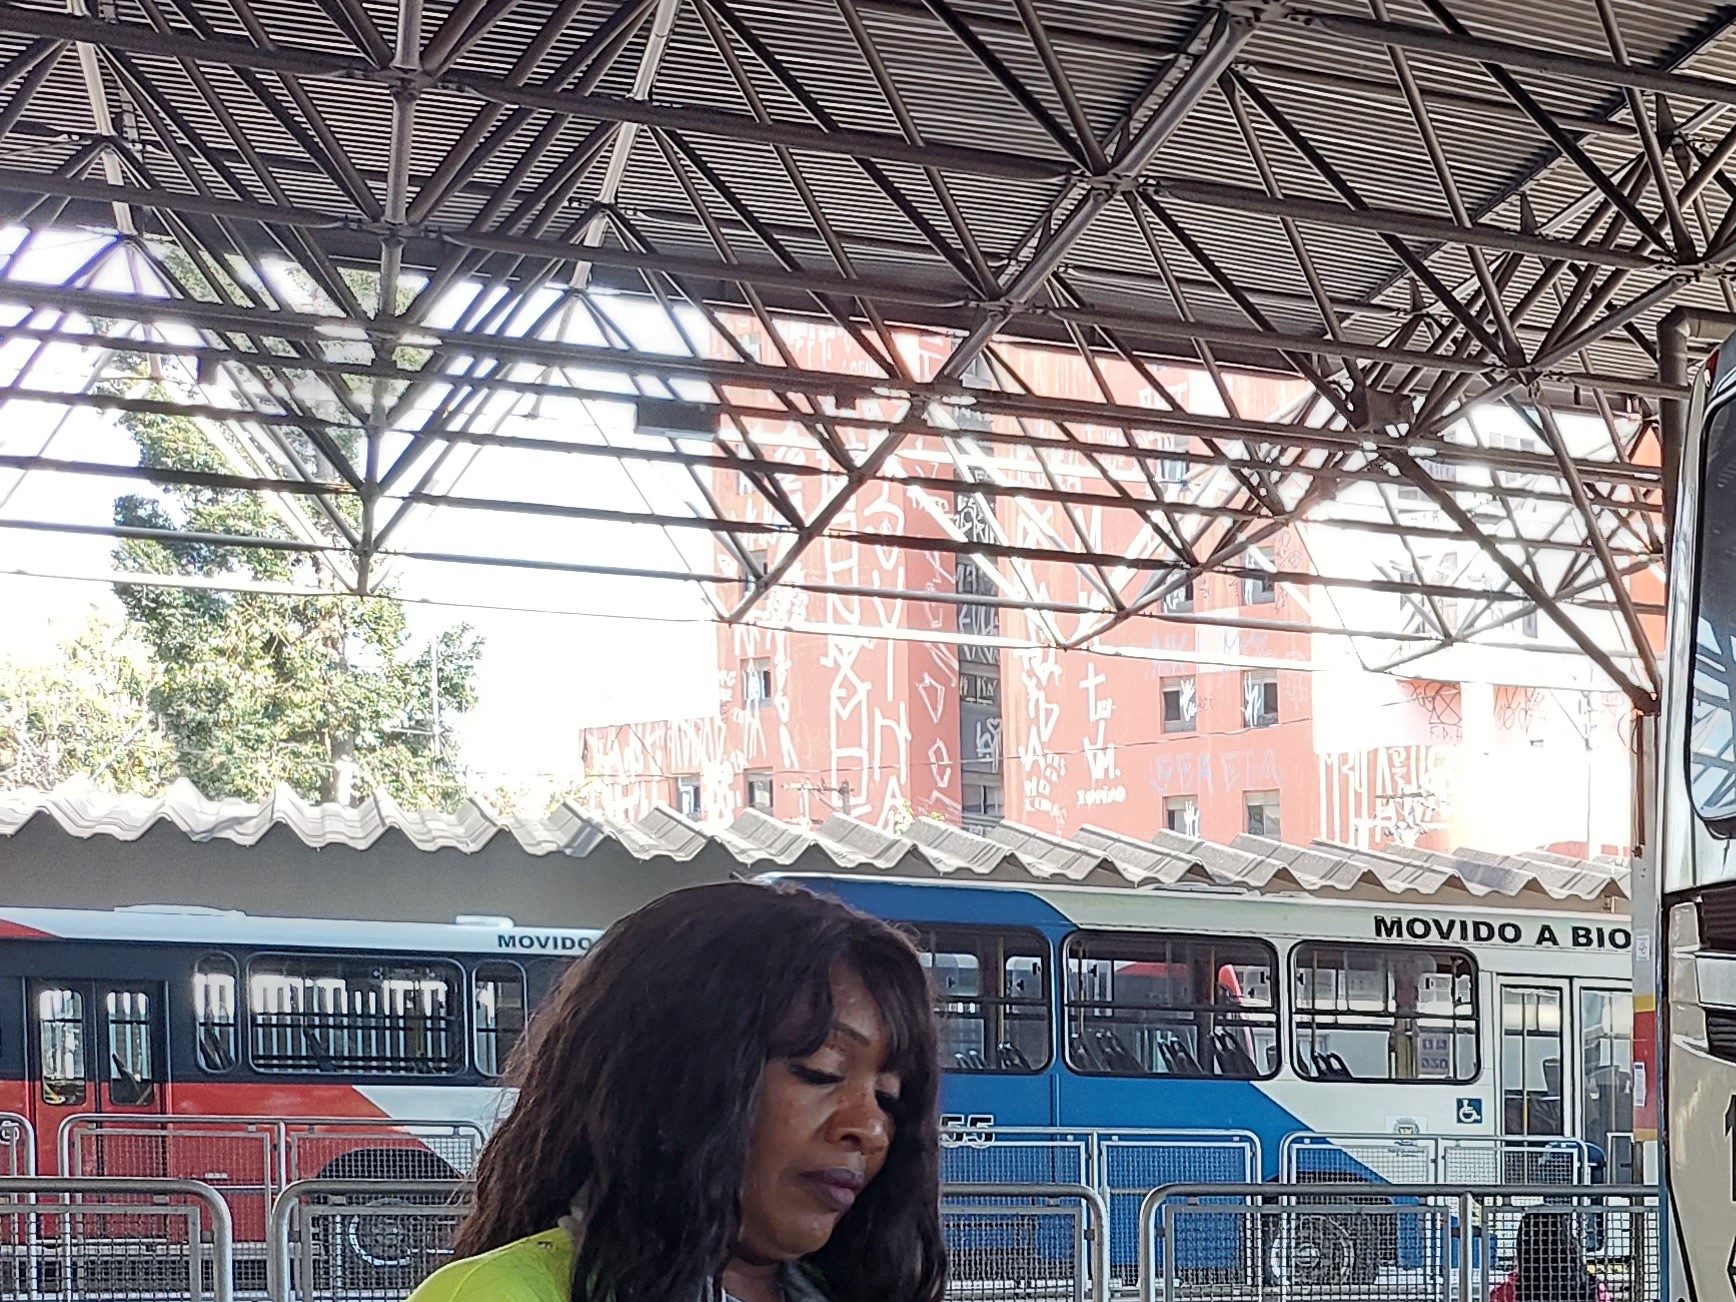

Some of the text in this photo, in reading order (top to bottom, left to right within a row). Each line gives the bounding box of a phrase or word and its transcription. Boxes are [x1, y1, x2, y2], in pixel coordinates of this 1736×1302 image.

[497, 934, 593, 951] MOVIDO
[1374, 914, 1632, 950] MOVIDO A BIO
